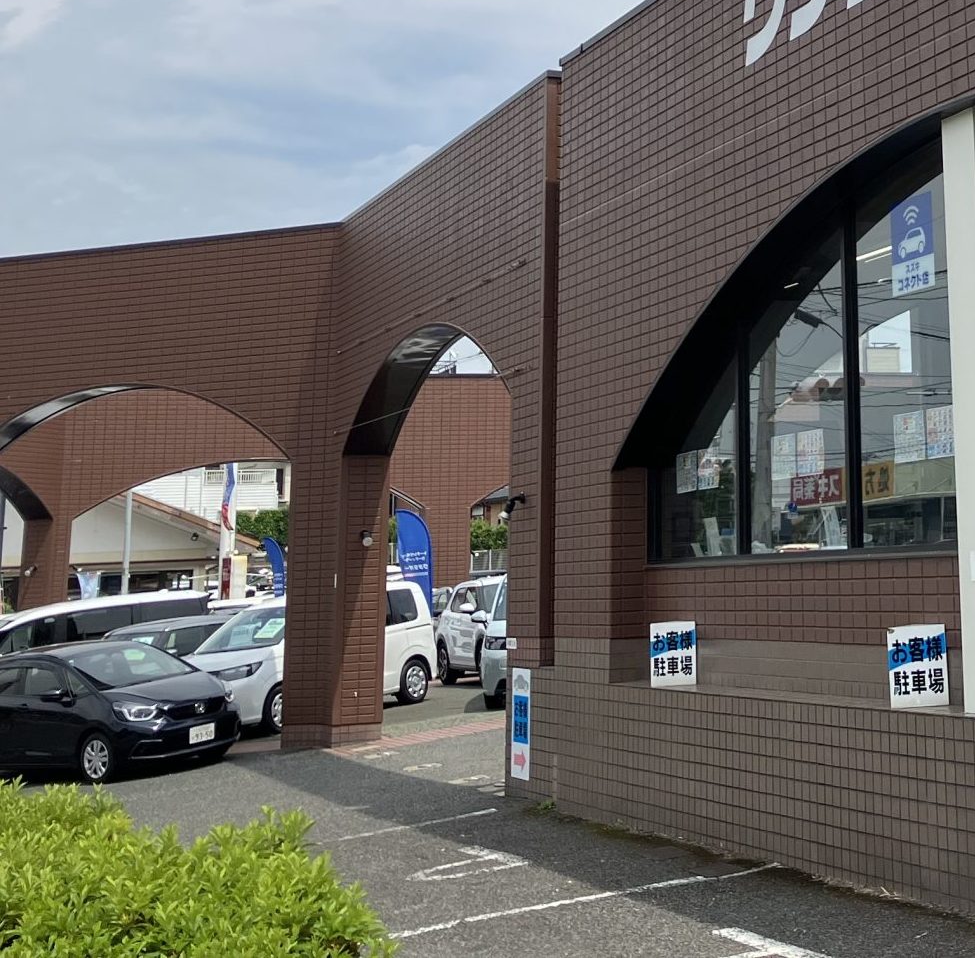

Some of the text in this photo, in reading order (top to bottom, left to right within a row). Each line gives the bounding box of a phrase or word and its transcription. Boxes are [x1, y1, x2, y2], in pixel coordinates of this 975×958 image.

[652, 630, 694, 652] お客様
[891, 635, 943, 663] お客様
[652, 655, 693, 677] 駐車場
[893, 667, 945, 696] 駐車場
